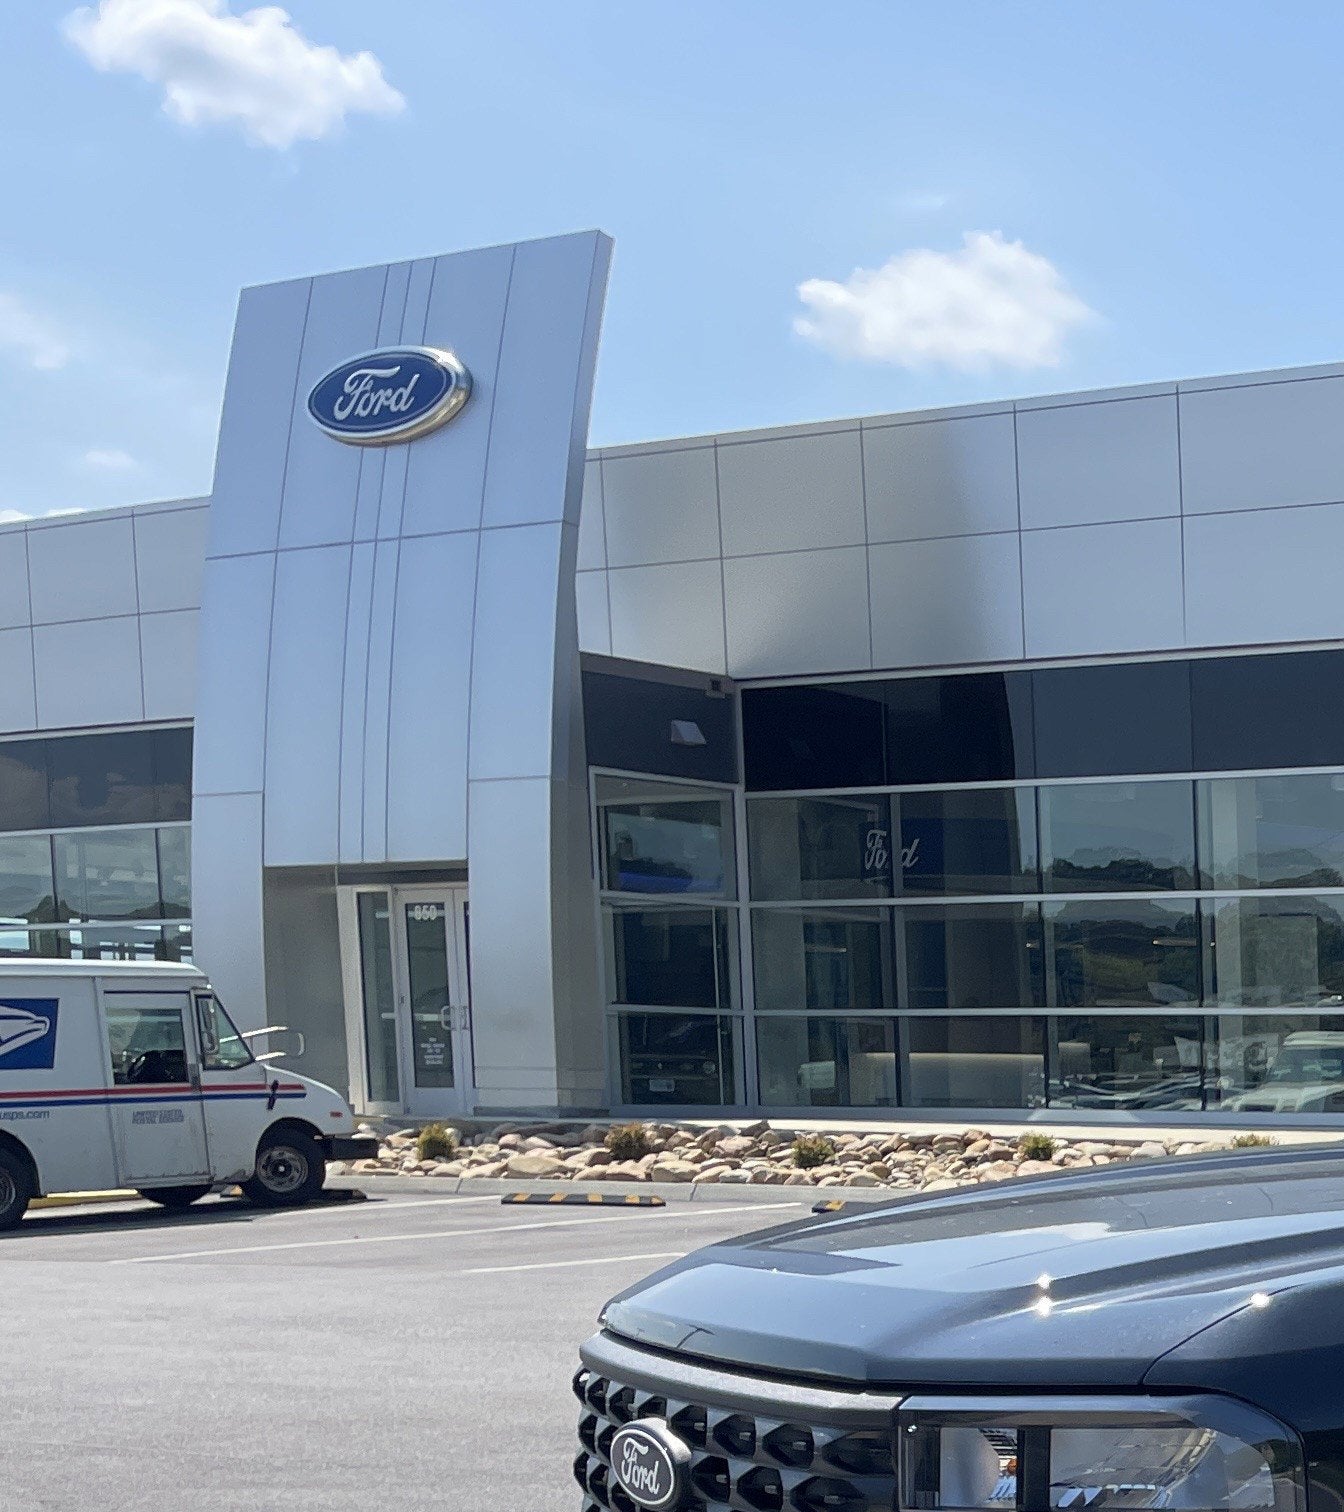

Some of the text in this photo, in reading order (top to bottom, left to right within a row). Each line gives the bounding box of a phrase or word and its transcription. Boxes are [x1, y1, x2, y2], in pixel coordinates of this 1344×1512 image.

[333, 365, 421, 421] Ford
[864, 829, 920, 869] Fod
[621, 1437, 660, 1495] Ford
